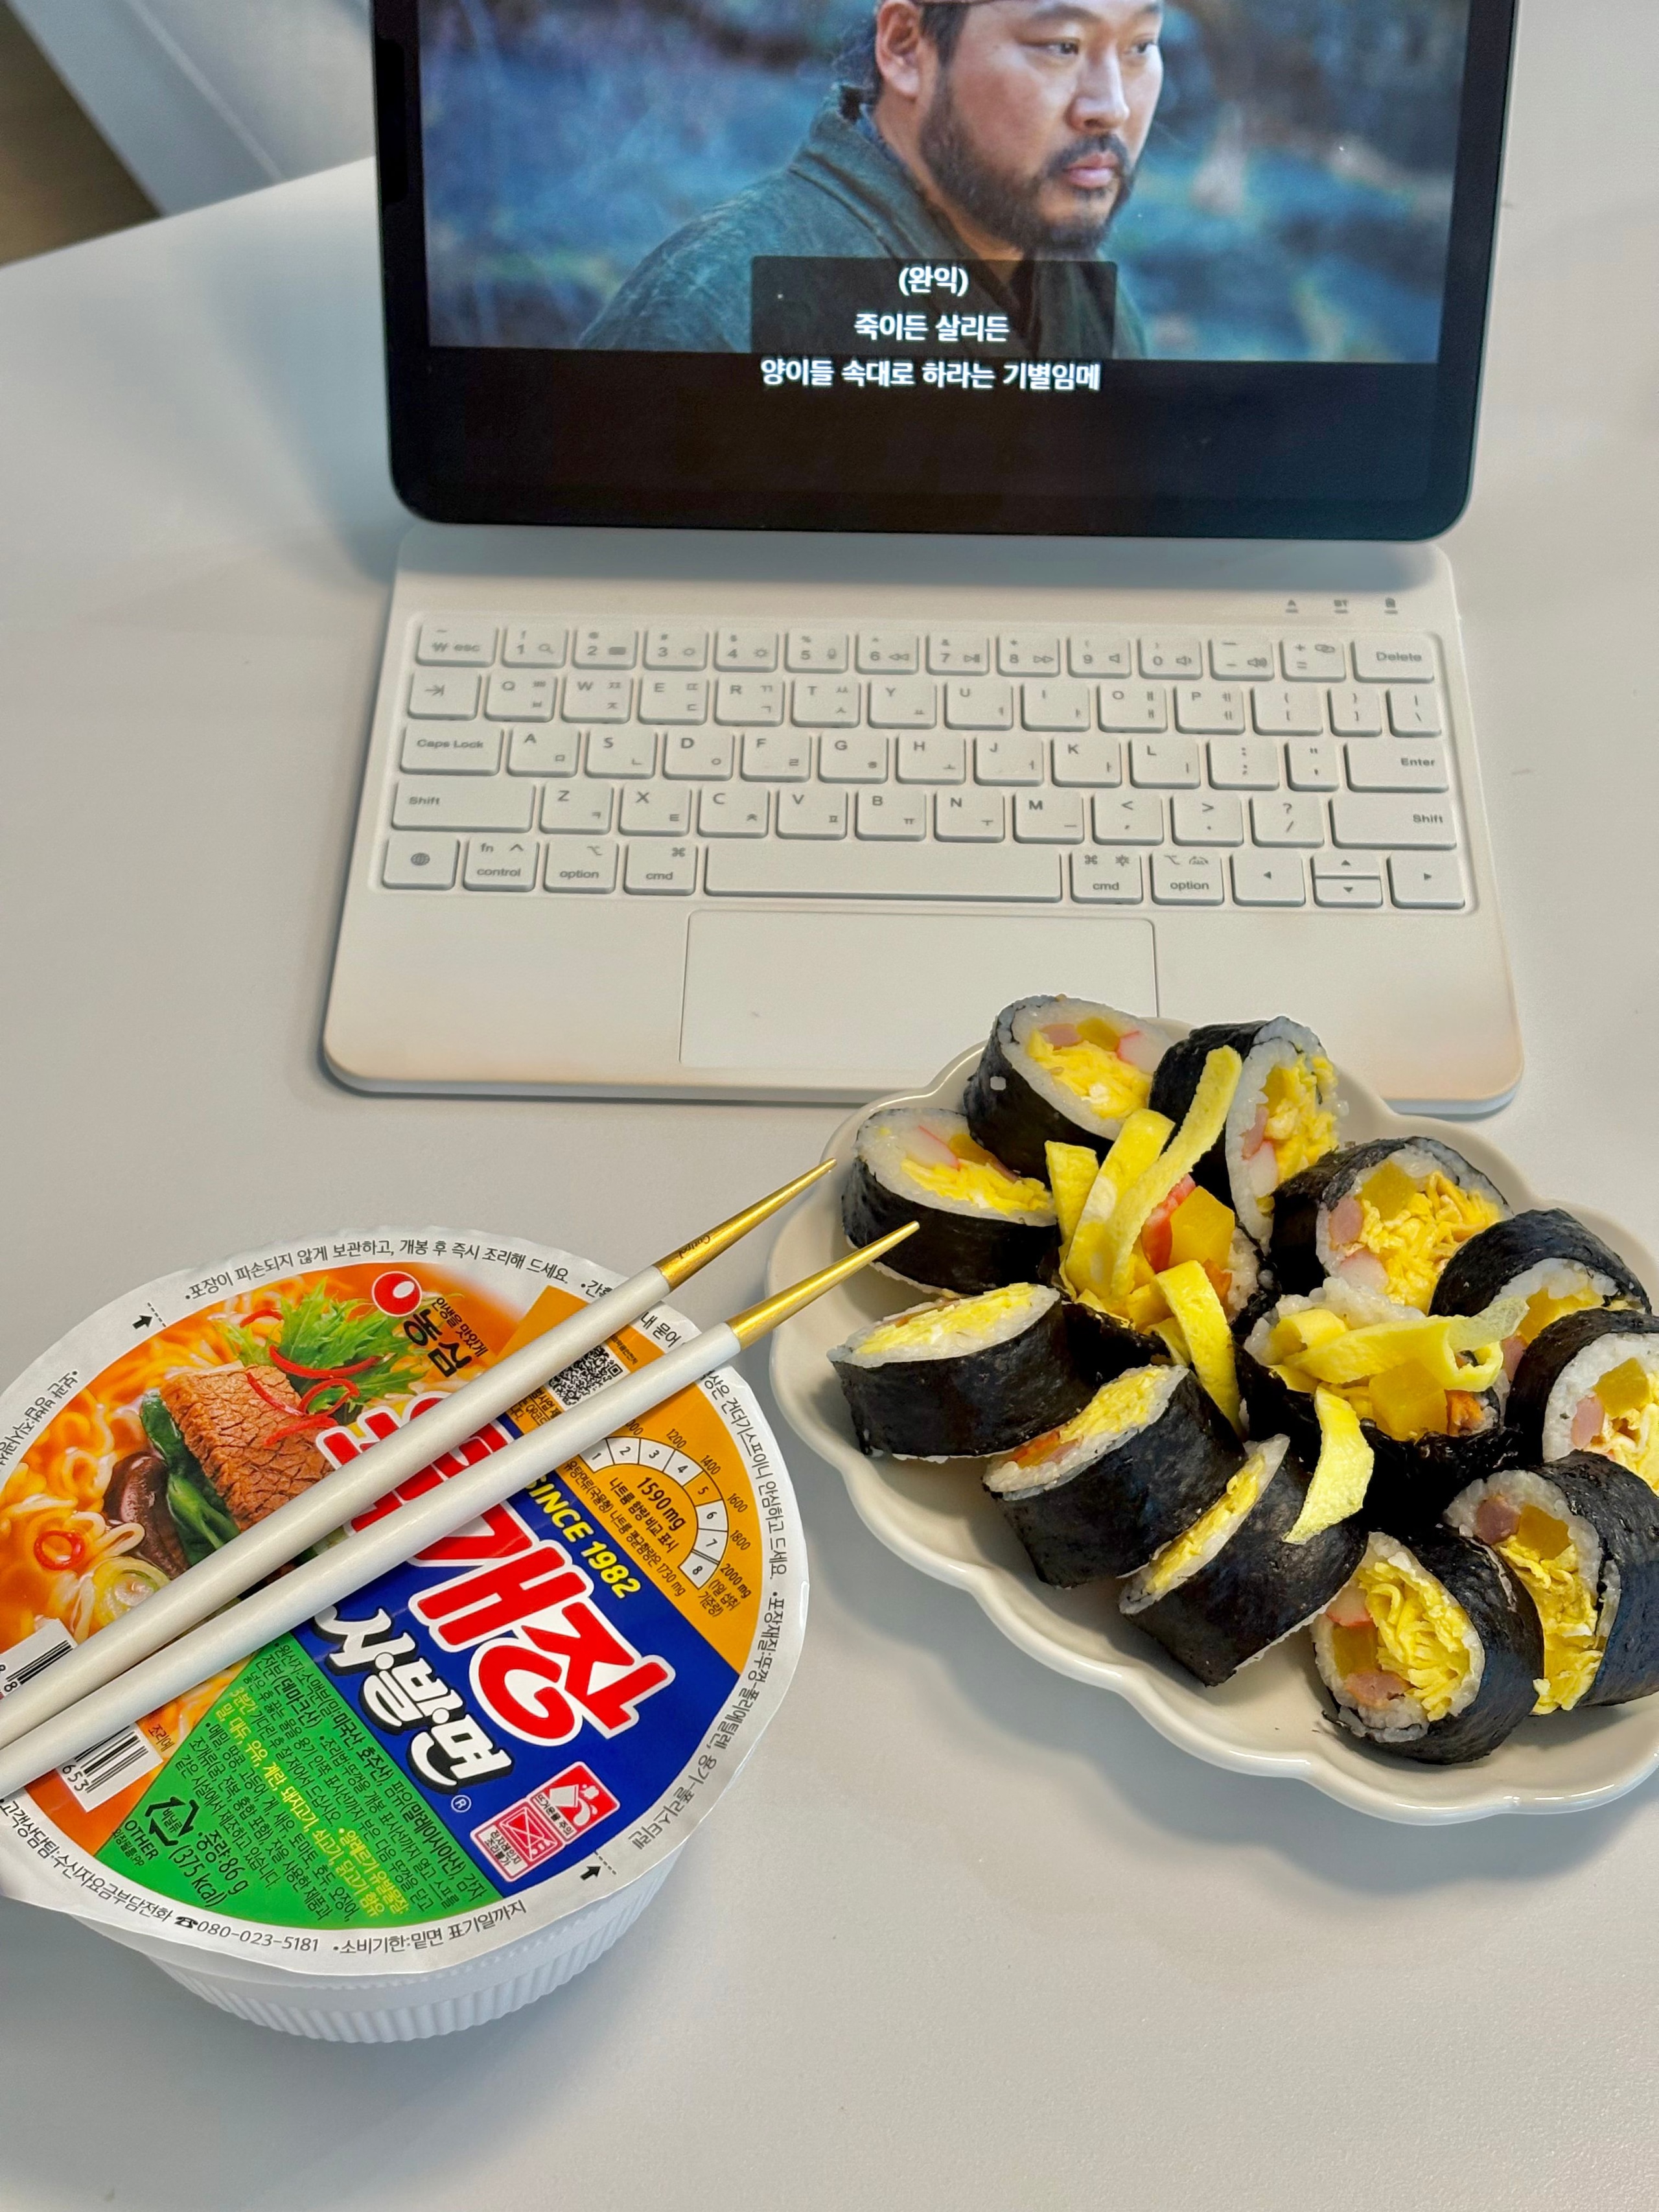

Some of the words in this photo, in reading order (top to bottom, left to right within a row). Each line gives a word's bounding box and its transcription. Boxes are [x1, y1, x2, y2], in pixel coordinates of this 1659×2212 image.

[899, 266, 968, 296] (완익)
[854, 313, 927, 342] 죽이든
[935, 314, 1009, 342] 살리든
[761, 358, 834, 386] 양이들
[842, 360, 915, 386] 속대로
[922, 362, 995, 389] 하라는
[1003, 362, 1100, 391] 기별임메
[1376, 651, 1422, 662] Delete
[417, 738, 450, 750] Caps
[454, 739, 483, 749] Lock
[524, 733, 537, 744] A
[603, 738, 614, 749] S
[680, 738, 694, 749] D
[756, 738, 766, 749] F
[835, 739, 848, 751] G
[914, 741, 925, 752] H
[990, 743, 999, 753] J
[1069, 743, 1079, 754] K
[1147, 745, 1157, 756] L
[1400, 757, 1435, 767] Enter
[408, 795, 440, 806] Shift
[1412, 813, 1443, 823] Shift
[476, 867, 521, 878] control
[559, 869, 599, 881] option
[645, 870, 673, 881] cmd
[1093, 880, 1120, 891] cmd
[1170, 879, 1209, 892] option
[189, 1272, 233, 1299] 포장이
[235, 1253, 293, 1280] 파손되지
[297, 1246, 328, 1264] 않게
[332, 1240, 394, 1257] 보관하고,
[400, 1239, 428, 1255] 개봉
[433, 1240, 447, 1256] 후
[452, 1242, 480, 1260] 즉시
[482, 1247, 526, 1270] 조리해
[526, 1258, 568, 1284] 드세요.
[431, 1297, 462, 1327] 인생을
[457, 1323, 488, 1358] 맛있게
[641, 1312, 657, 1329] 내
[403, 1309, 473, 1378] 농심
[653, 1323, 681, 1347] 묻어
[47, 1373, 78, 1399] 보관
[627, 1419, 644, 1436] 000
[666, 1428, 687, 1449] 1200
[721, 1398, 772, 1479] 건더기스프이니
[620, 1446, 631, 1456] 2
[649, 1450, 660, 1459] 3
[677, 1465, 688, 1473] 4
[700, 1454, 721, 1475] 1400
[698, 1486, 709, 1495] 5
[637, 1477, 671, 1510] 1590
[663, 1507, 686, 1531] mg
[727, 1493, 748, 1512] 1600
[759, 1482, 783, 1533] 안심하고
[609, 1477, 635, 1506] 나트륨
[628, 1500, 648, 1521] 함량
[645, 1516, 663, 1537] 비교
[658, 1533, 679, 1554] 표시
[524, 1479, 594, 1543] SINCE
[581, 1541, 642, 1600] 1982
[565, 1460, 612, 1514] 유탕면류(국물형)
[610, 1510, 632, 1534] 나트륨
[626, 1530, 661, 1568] 평균함량은
[657, 1565, 676, 1583] 1730
[673, 1583, 686, 1597] mg
[706, 1539, 718, 1547] 7
[729, 1530, 751, 1550] 1800
[769, 1538, 787, 1579] 드세요.
[692, 1566, 702, 1575] 8
[721, 1563, 742, 1585] 2000
[736, 1585, 751, 1600] mg
[698, 1590, 725, 1618] 기준량)
[708, 1579, 726, 1597] (1일
[720, 1592, 738, 1611] 섭취
[243, 1671, 265, 1692] 넣은
[256, 1655, 322, 1728] 전분(덴마크산)
[230, 1687, 259, 1715] 3분간
[259, 1690, 273, 1701] 후
[314, 1605, 512, 1787] 사발면
[264, 1701, 284, 1721] 끓는
[250, 1710, 277, 1740] 기다린
[277, 1716, 303, 1742] 물을
[148, 1725, 174, 1752] 조리예
[269, 1737, 284, 1748] 후
[294, 1738, 318, 1758] 용기
[275, 1747, 293, 1760] 잘
[286, 1757, 315, 1787] 저어서
[308, 1756, 332, 1777] 안쪽
[62, 1765, 89, 1791] 653
[176, 1754, 198, 1778] 같은
[192, 1776, 226, 1815] 시설에서
[218, 1810, 251, 1851] 제조하고
[324, 1775, 366, 1822] 표시선까지
[157, 1808, 184, 1835] 비닐류
[216, 1701, 235, 1723] 밀,
[230, 1717, 251, 1744] 대두,
[246, 1741, 268, 1767] 우유,
[263, 1762, 287, 1791] 계란,
[281, 1786, 319, 1832] 돼지고기,
[312, 1829, 344, 1865] 쇠고기,
[336, 1860, 369, 1895] 닭고기
[358, 1889, 388, 1921] 함유
[189, 1737, 226, 1782] 조개류(굴,
[218, 1775, 241, 1802] 전복,
[231, 1793, 259, 1821] 홍합
[249, 1816, 273, 1845] 포함),
[266, 1839, 289, 1863] 잣을
[283, 1861, 311, 1892] 사용한
[305, 1887, 332, 1920] 제품과
[209, 1725, 230, 1750] 메밀,
[223, 1745, 246, 1772] 땅콩,
[239, 1768, 269, 1802] 고등어,
[263, 1797, 279, 1816] 게,
[274, 1811, 294, 1838] 새우,
[289, 1834, 318, 1870] 토마토,
[312, 1865, 335, 1891] 호두,
[329, 1887, 360, 1922] 오징어,
[356, 1747, 393, 1786] 호주산),
[457, 1874, 487, 1902] 감자
[358, 1819, 380, 1841] 부은
[557, 1819, 574, 1836] 주의
[124, 1819, 159, 1860] OTHER
[365, 1791, 386, 1813] 개봉
[379, 1812, 423, 1861] 표시선까지
[413, 1858, 436, 1881] 열고
[429, 1881, 459, 1909] 스프를
[375, 1839, 396, 1862] 다음
[340, 1828, 382, 1877] 알레르기
[168, 1845, 205, 1877] (375
[192, 1873, 227, 1907] kcal)
[389, 1860, 418, 1892] 뚜껑을
[228, 1881, 248, 1894] g
[410, 1889, 434, 1911] 닫고
[339, 1931, 443, 1954] 소비기한:밑면
[448, 1900, 527, 1940] 표기일까지
